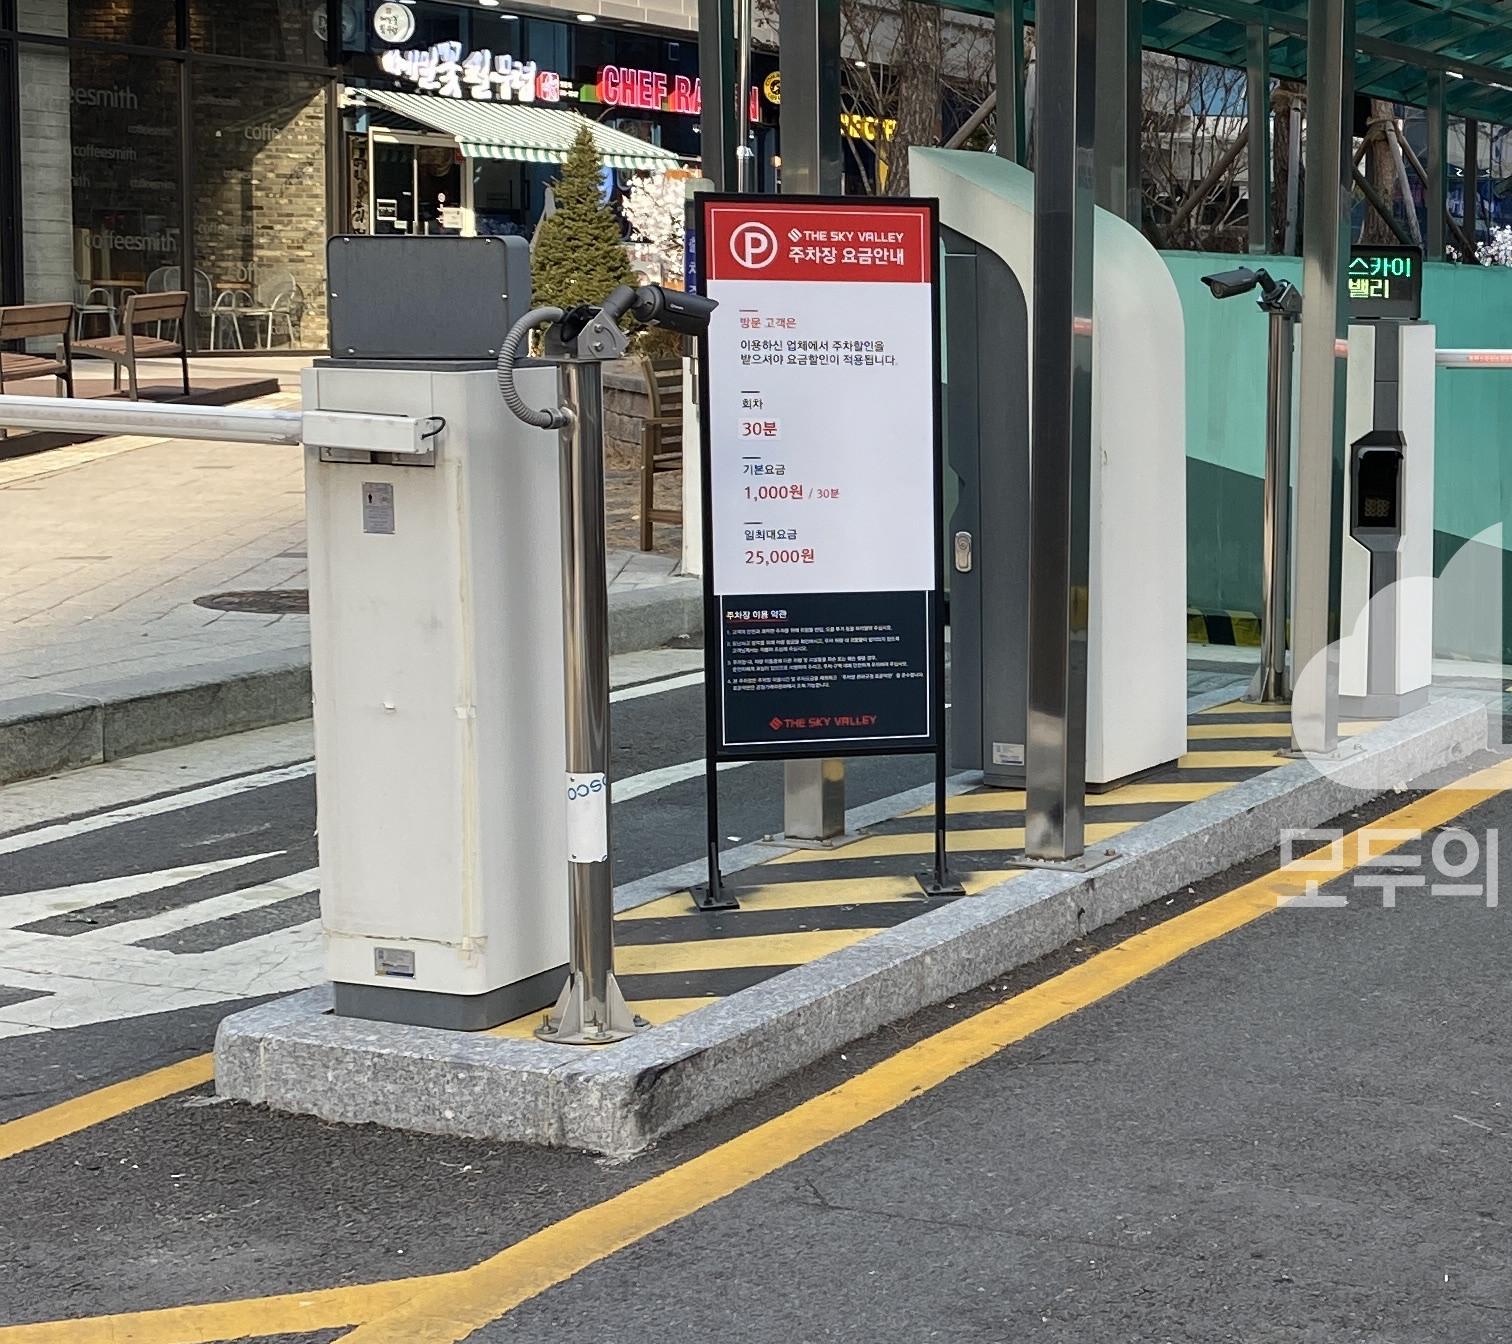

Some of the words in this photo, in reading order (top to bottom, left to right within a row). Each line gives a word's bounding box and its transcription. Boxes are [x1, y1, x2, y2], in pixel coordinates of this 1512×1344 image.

[602, 64, 668, 110] CHEF
[803, 230, 827, 242] THE
[831, 230, 854, 242] SKY
[857, 231, 904, 243] VALLEY
[788, 246, 837, 265] 주차장
[842, 247, 904, 266] 요금안내
[1348, 256, 1411, 278] 스카이
[739, 317, 762, 329] 방문
[765, 317, 797, 329] 고객은
[740, 339, 783, 352] 이용하신
[786, 339, 829, 352] 업체에서
[832, 340, 885, 352] 주차할인을
[740, 354, 784, 366] 받으셔야
[786, 354, 840, 366] 요금할인이
[843, 354, 898, 367] 적용됩니다.
[741, 398, 764, 410] 회차
[742, 421, 778, 437] 30분
[743, 464, 786, 476] 기본요금
[744, 484, 804, 501] 1,000원
[816, 488, 840, 499] 30분
[744, 529, 798, 541] 일최대요금
[745, 548, 815, 566] 25,000원
[726, 610, 750, 620] 주차장
[783, 718, 807, 729] THE
[808, 717, 831, 729] SKY
[834, 715, 877, 727] VALLEY
